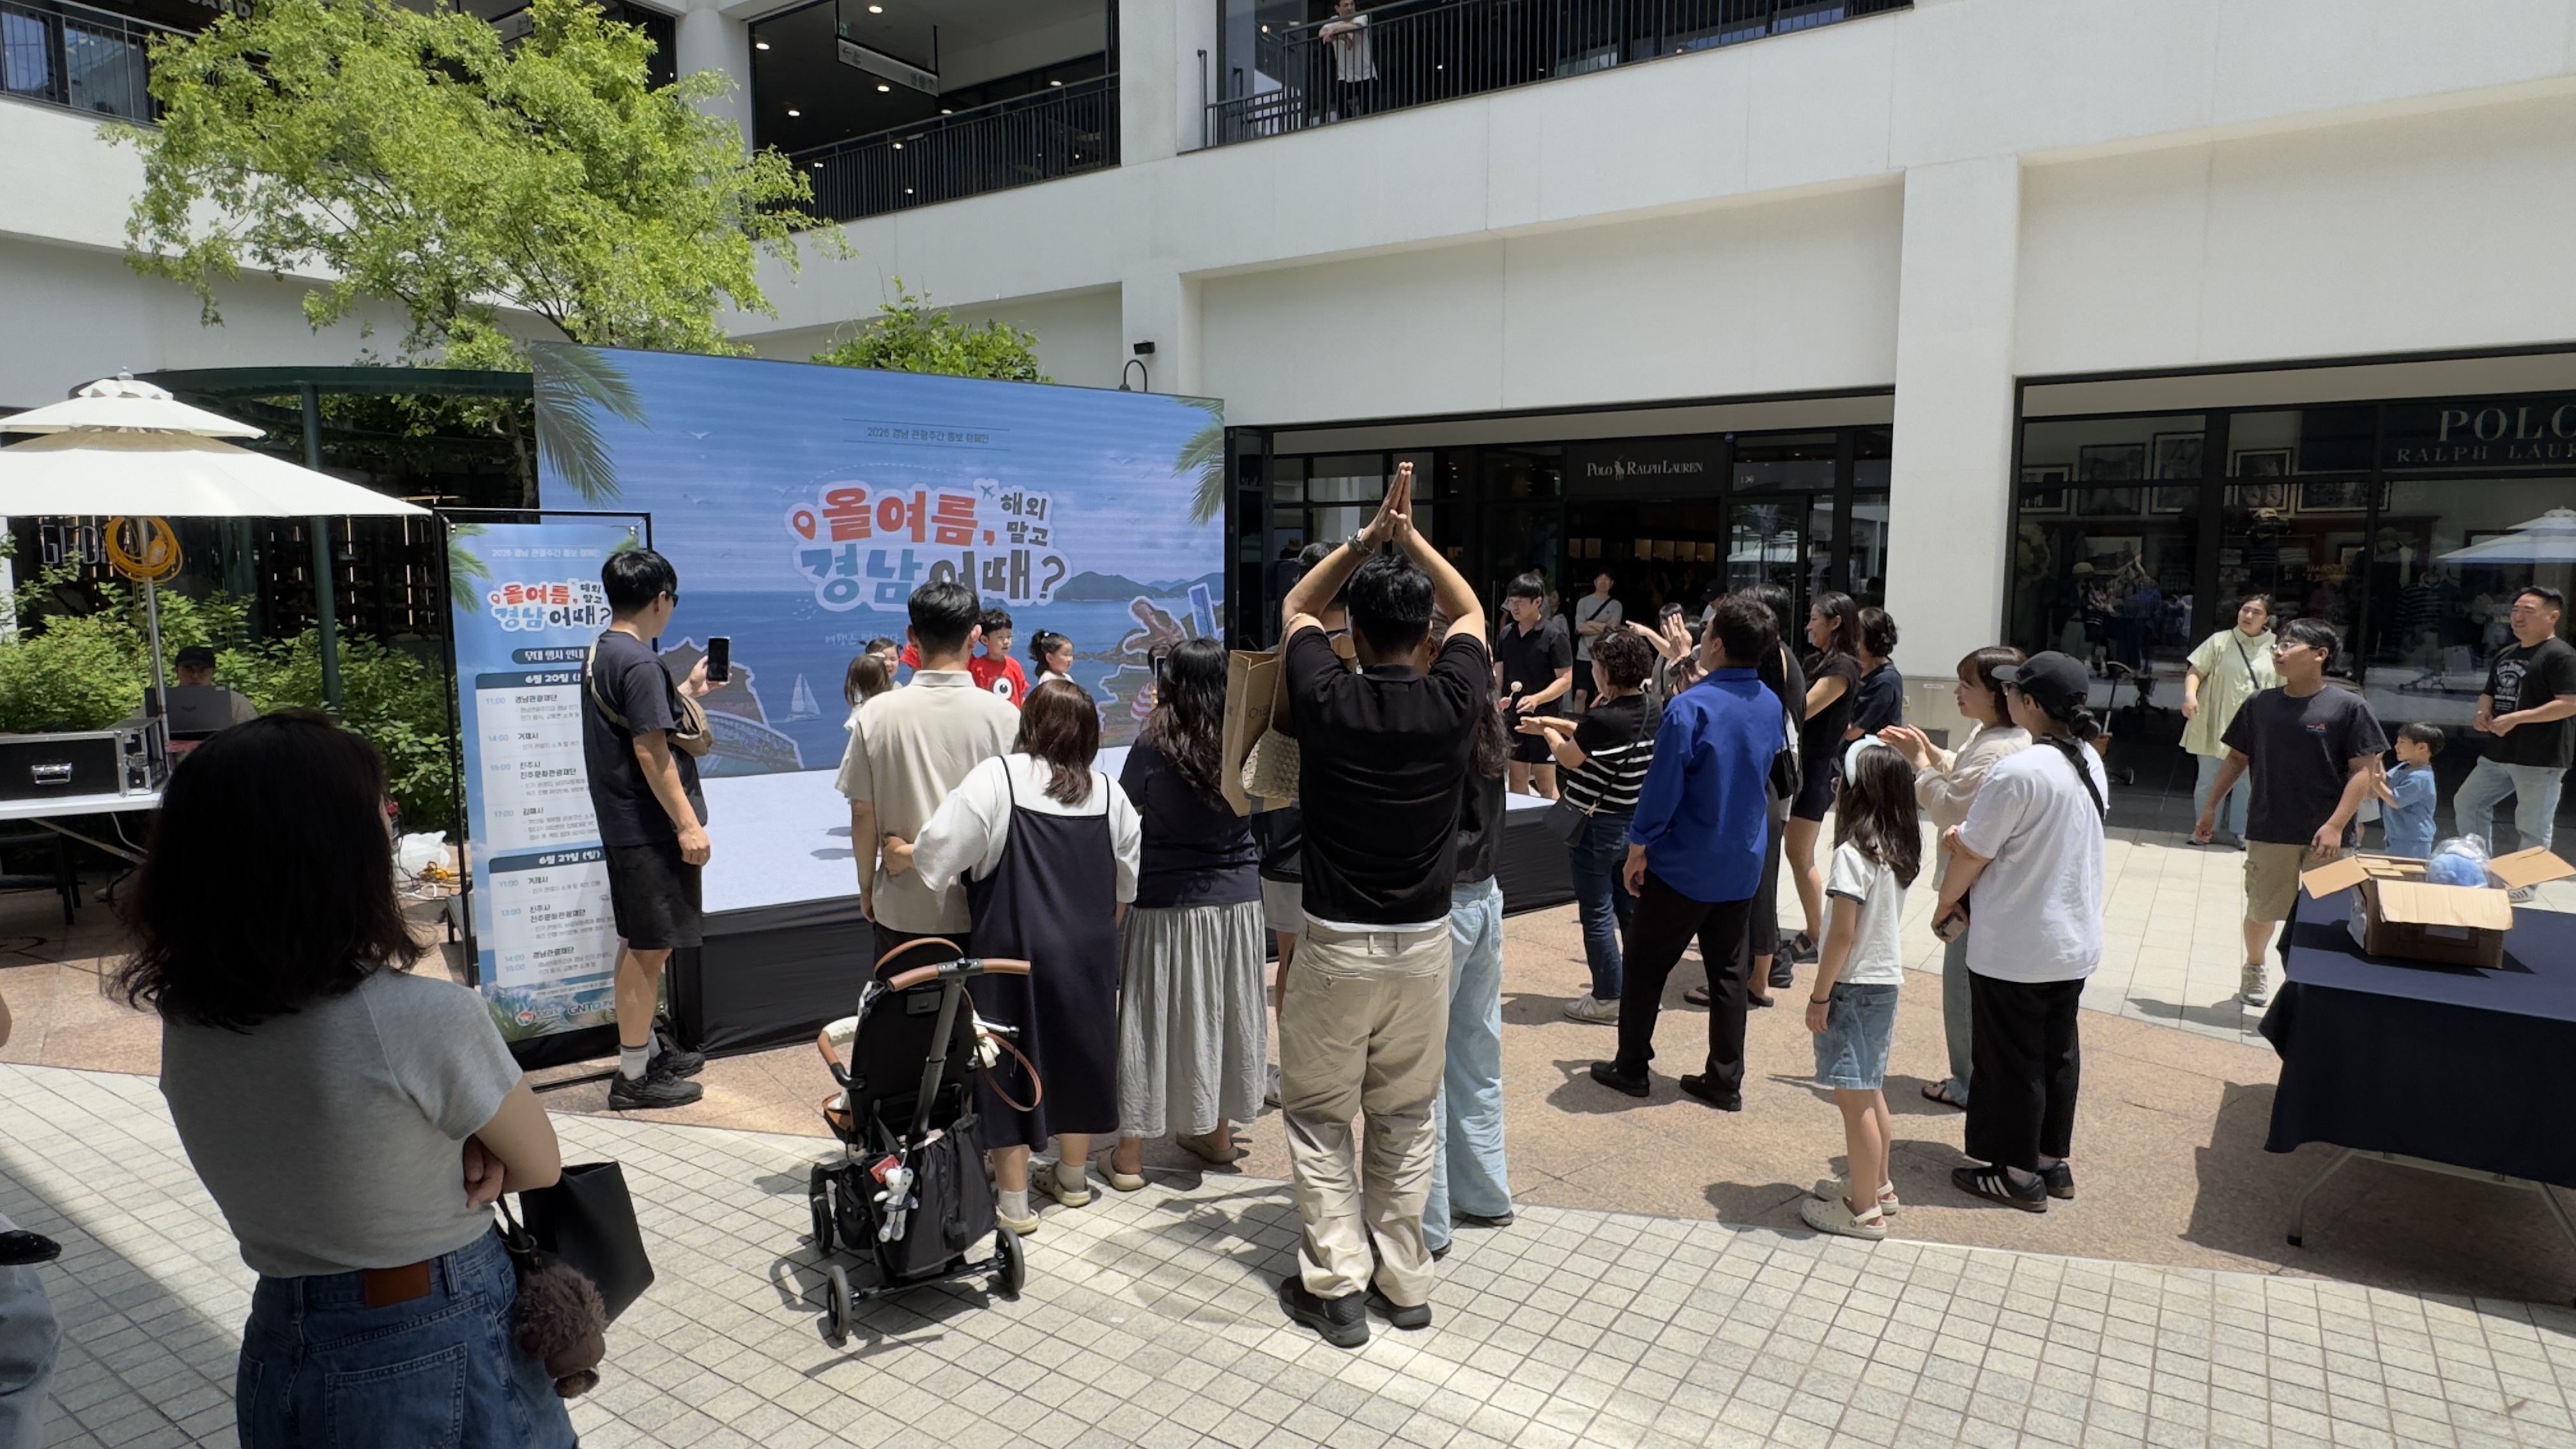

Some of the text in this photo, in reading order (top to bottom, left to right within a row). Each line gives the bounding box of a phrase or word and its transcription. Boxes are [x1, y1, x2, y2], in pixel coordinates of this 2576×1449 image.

[2439, 404, 2576, 441] POLO
[868, 427, 889, 438] 2026
[893, 428, 908, 440] 경남
[912, 429, 944, 441] 관광주간
[2397, 447, 2488, 463] RALPH
[1000, 493, 1046, 521] 해외
[822, 487, 995, 547] 올여름,
[1006, 521, 1048, 547] 말고
[801, 543, 1066, 604] 경남 어때?
[503, 585, 578, 605] 올여름,
[580, 583, 601, 594] 해외
[583, 594, 602, 604] 말고
[494, 605, 611, 629] 경남 어때?
[525, 674, 542, 685] 6월
[545, 673, 569, 683] 20일
[486, 696, 506, 705] 11:00
[539, 855, 555, 865] 6월
[569, 1002, 601, 1015] GNTO
